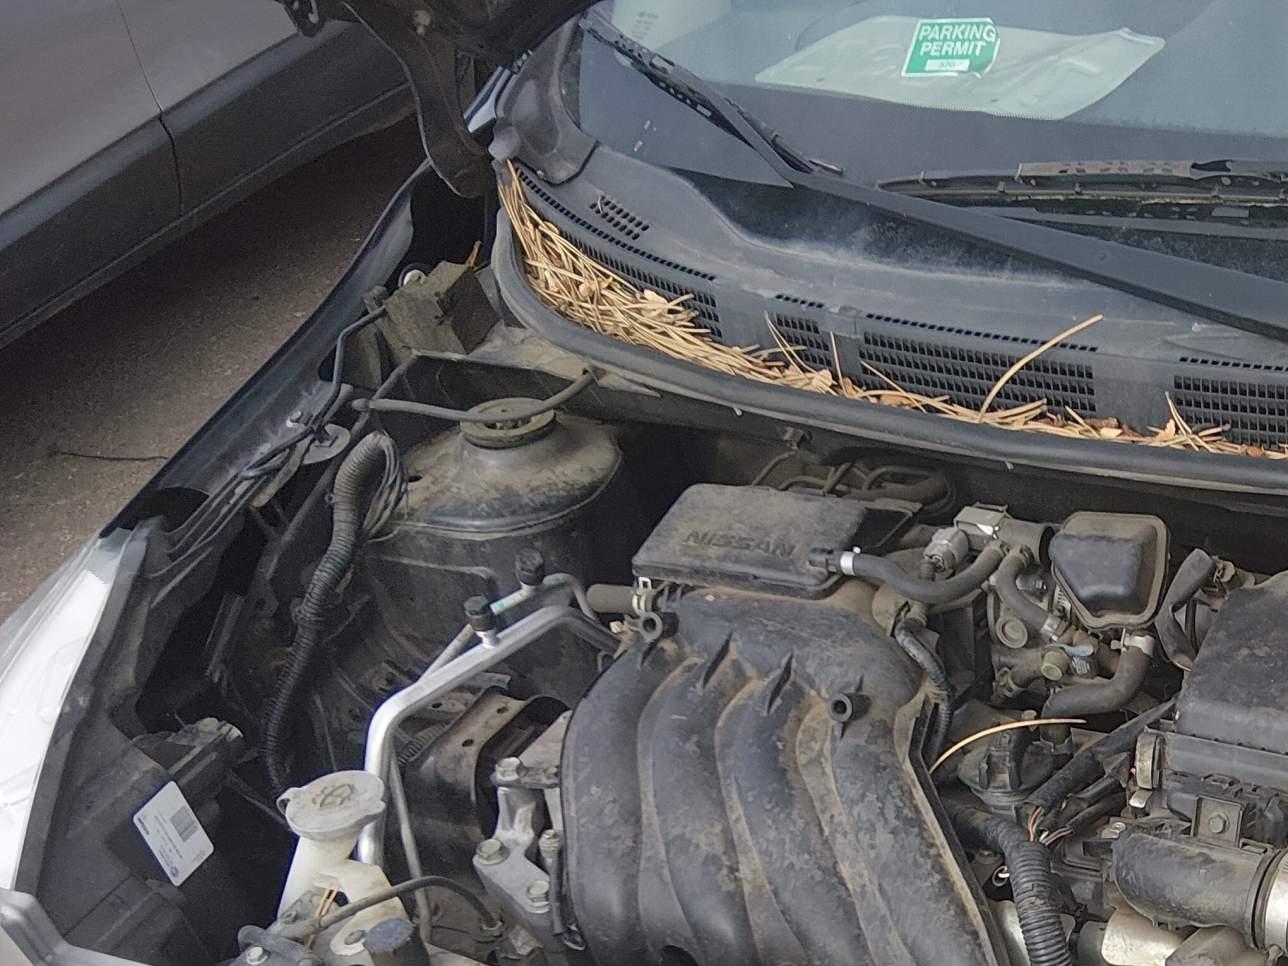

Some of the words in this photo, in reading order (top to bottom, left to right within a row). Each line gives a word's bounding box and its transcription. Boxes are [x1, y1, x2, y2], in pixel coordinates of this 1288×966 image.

[919, 24, 997, 42] PARKING
[920, 41, 986, 56] PERMIT
[682, 530, 796, 556] NISSAN
